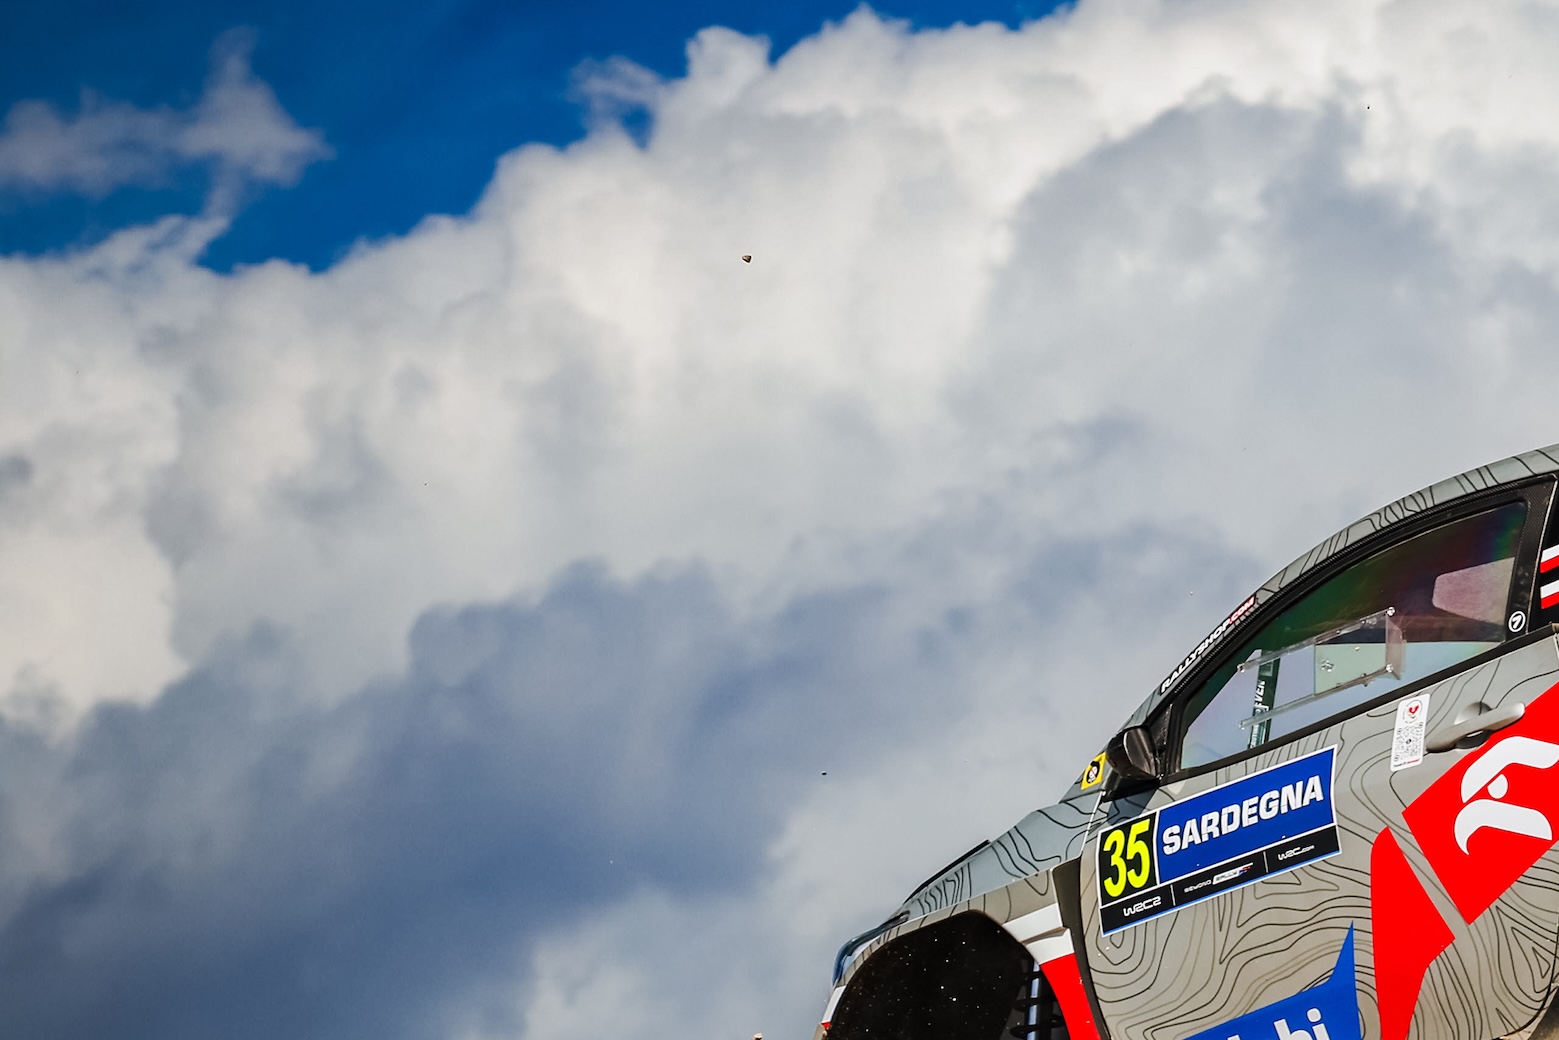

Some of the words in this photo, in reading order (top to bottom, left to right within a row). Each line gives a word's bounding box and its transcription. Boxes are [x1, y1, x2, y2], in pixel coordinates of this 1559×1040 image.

[1103, 818, 1151, 897] 35
[1162, 775, 1324, 856] SARDEGNA
[1123, 895, 1162, 917] WRC2
